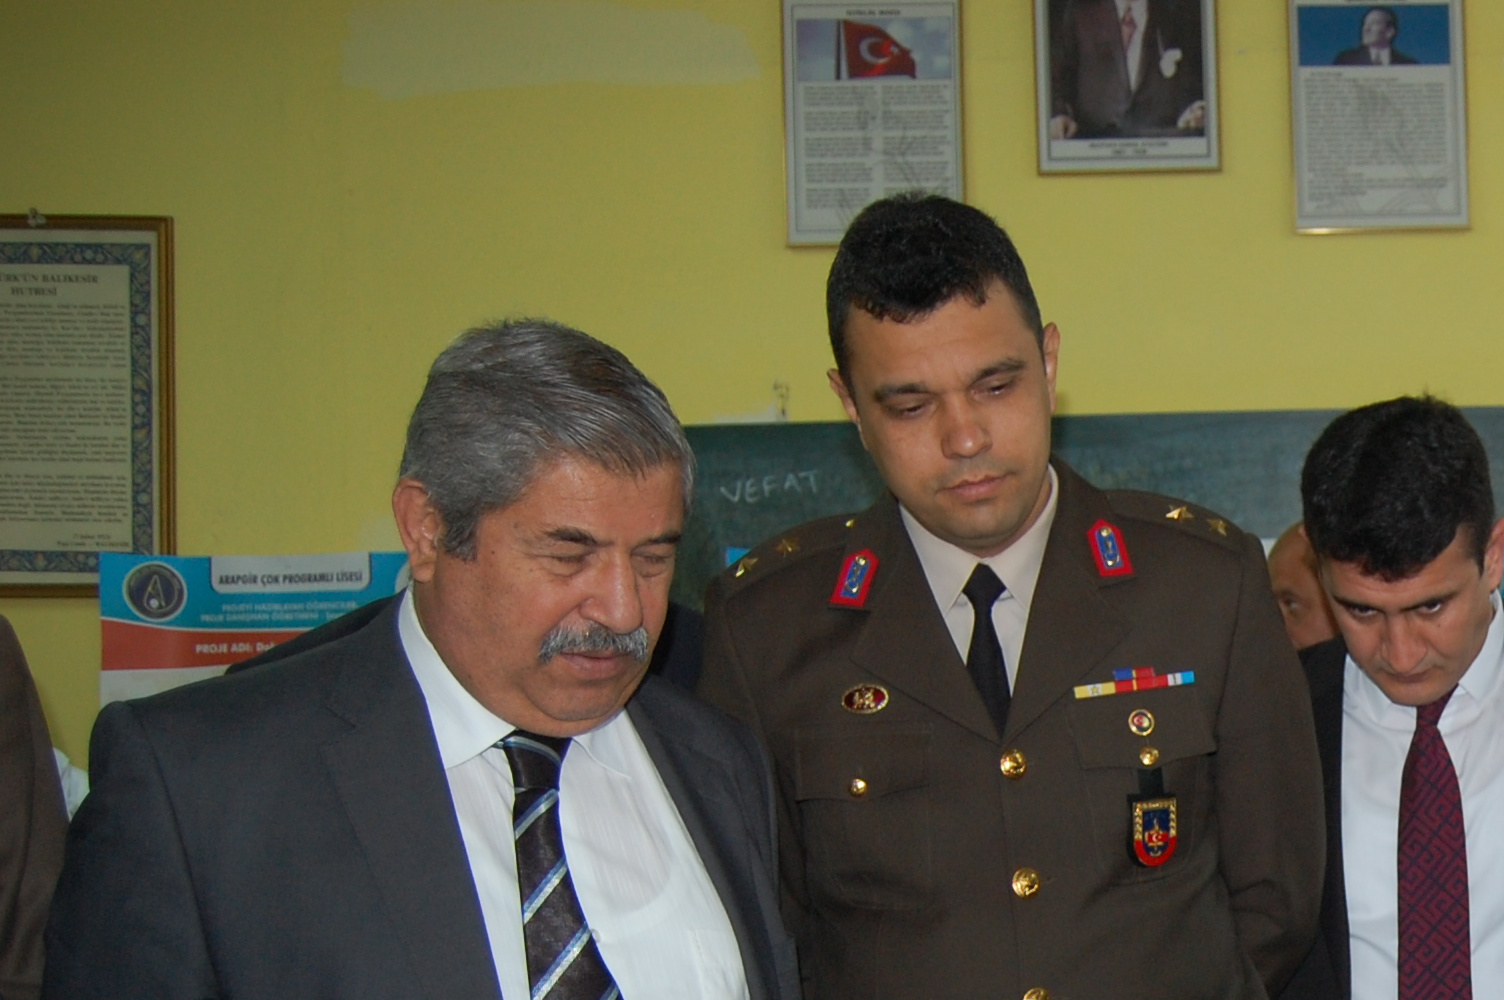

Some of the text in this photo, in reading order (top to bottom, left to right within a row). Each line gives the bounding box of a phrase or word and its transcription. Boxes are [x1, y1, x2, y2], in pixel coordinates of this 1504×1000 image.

[720, 469, 818, 503] VEFAT
[261, 573, 280, 587] ÇOK
[282, 572, 334, 584] PROGRAMLI
[196, 643, 228, 654] PROJE
